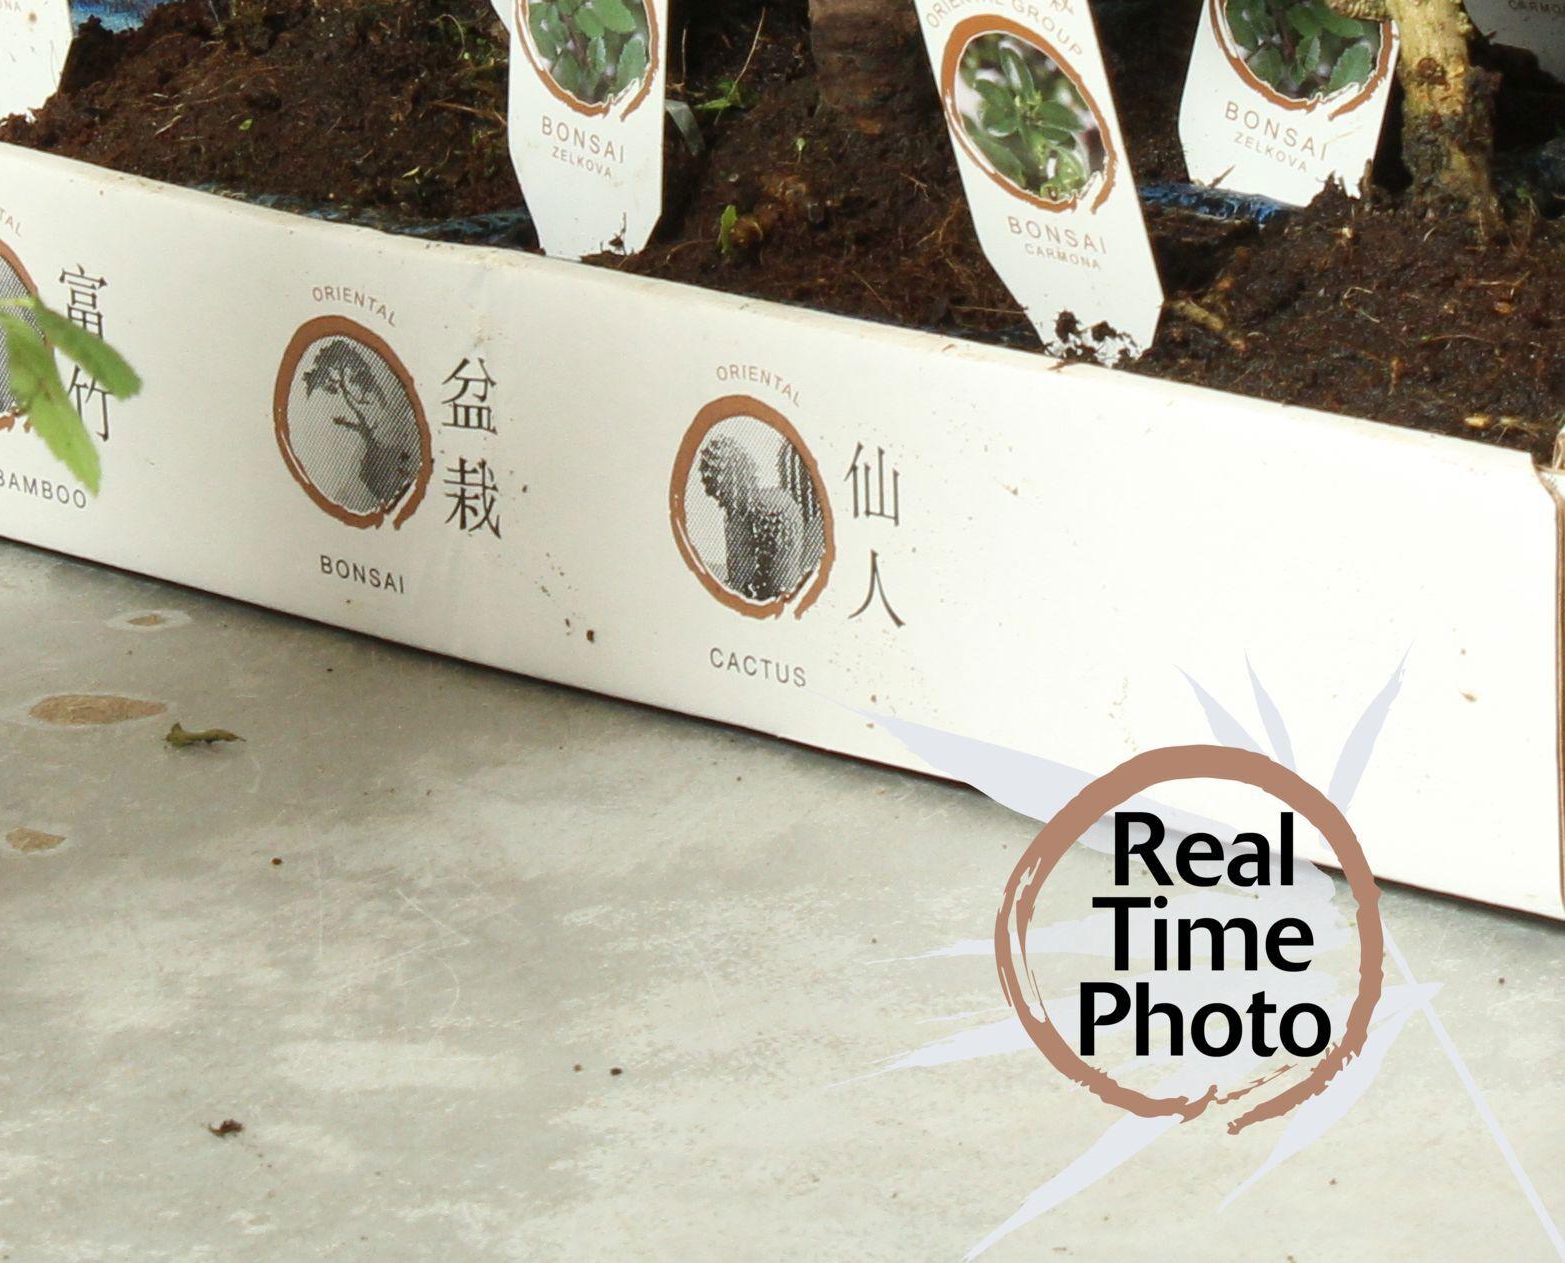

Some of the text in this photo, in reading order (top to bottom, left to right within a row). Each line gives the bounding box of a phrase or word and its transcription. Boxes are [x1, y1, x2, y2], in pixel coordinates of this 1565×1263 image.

[541, 114, 624, 164] BONSAI
[1224, 99, 1328, 162] BONSAI
[1233, 131, 1308, 173] ZELKOVA
[551, 145, 612, 178] ZELKOVA
[1007, 215, 1107, 255] BONSAI
[1024, 242, 1102, 270] CARMONA
[311, 284, 398, 328] ORIENTAL
[716, 363, 803, 408] ORIENTAL
[441, 356, 502, 540] 盆栽
[845, 442, 907, 630] 仙人
[319, 554, 406, 595] BONSAI
[709, 647, 808, 689] CACTUS
